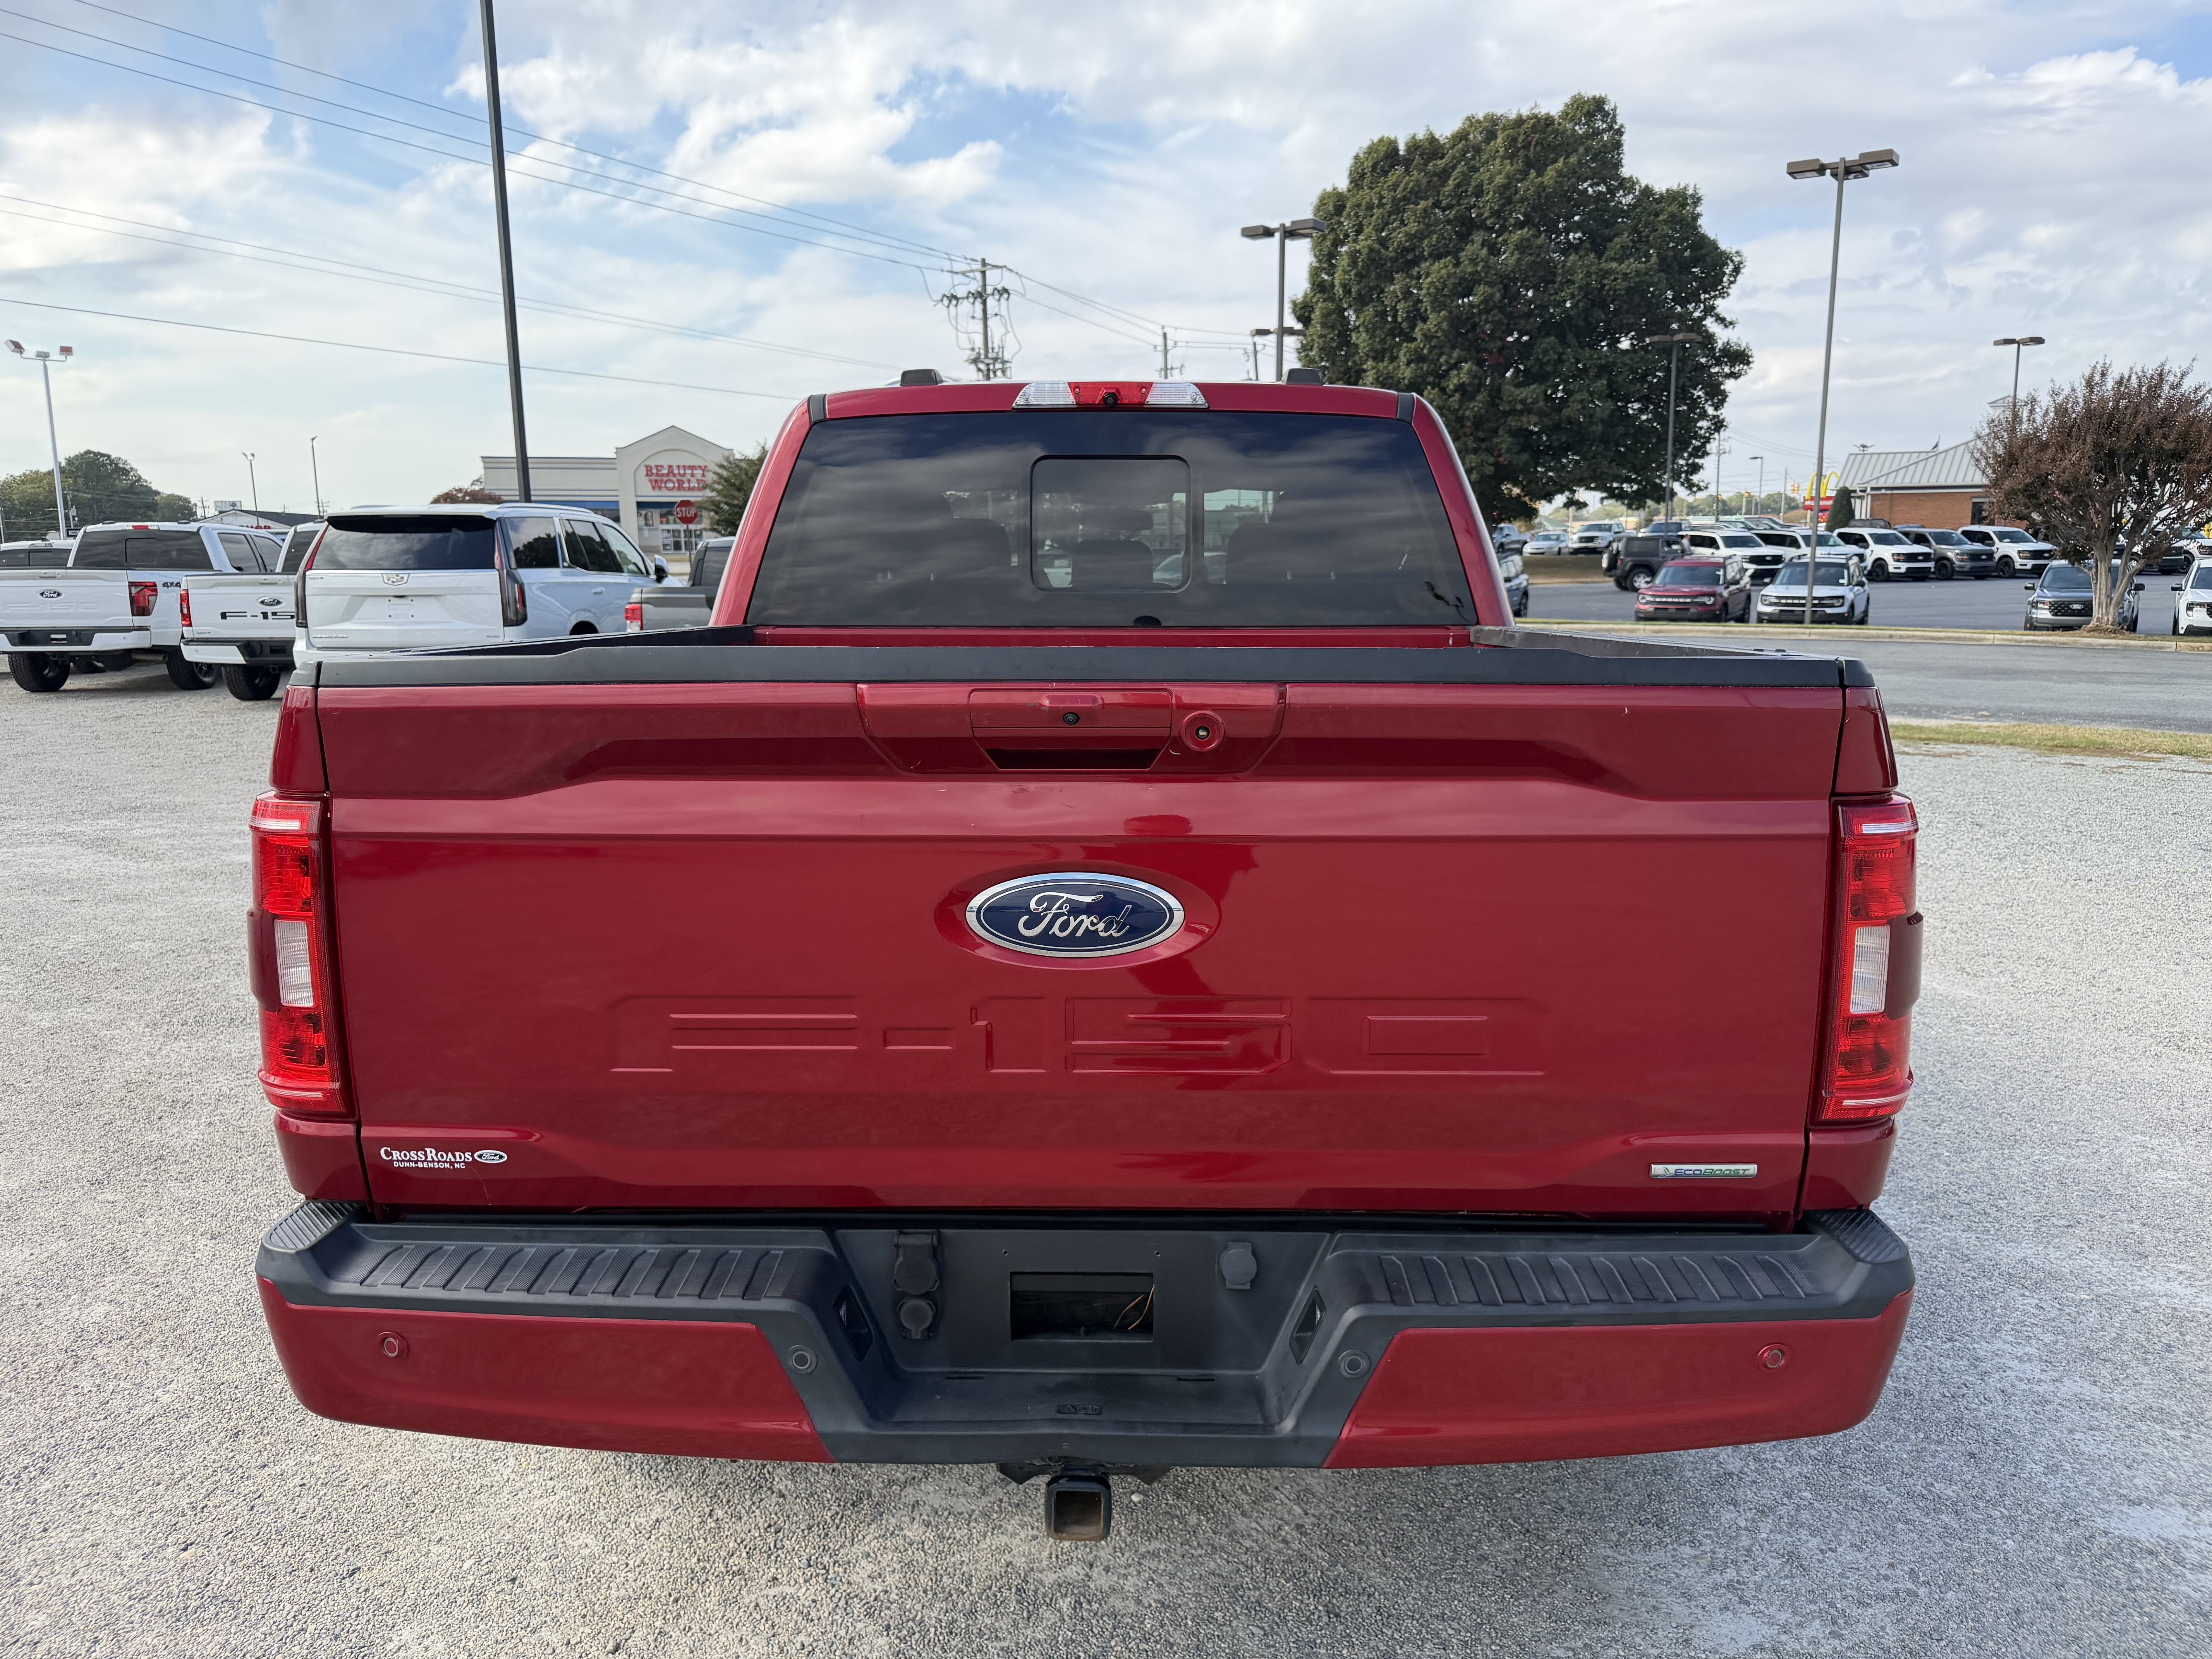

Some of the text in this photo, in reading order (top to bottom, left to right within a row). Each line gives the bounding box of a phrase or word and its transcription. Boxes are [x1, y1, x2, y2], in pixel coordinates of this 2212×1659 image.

[644, 465, 708, 477] BEAUTY
[648, 479, 707, 491] WORLD
[677, 507, 696, 517] STOP
[220, 611, 295, 620] F-15
[1018, 891, 1132, 937] Ford
[609, 995, 1546, 1073] F-150
[393, 1161, 453, 1169] DUNN-BENSON,
